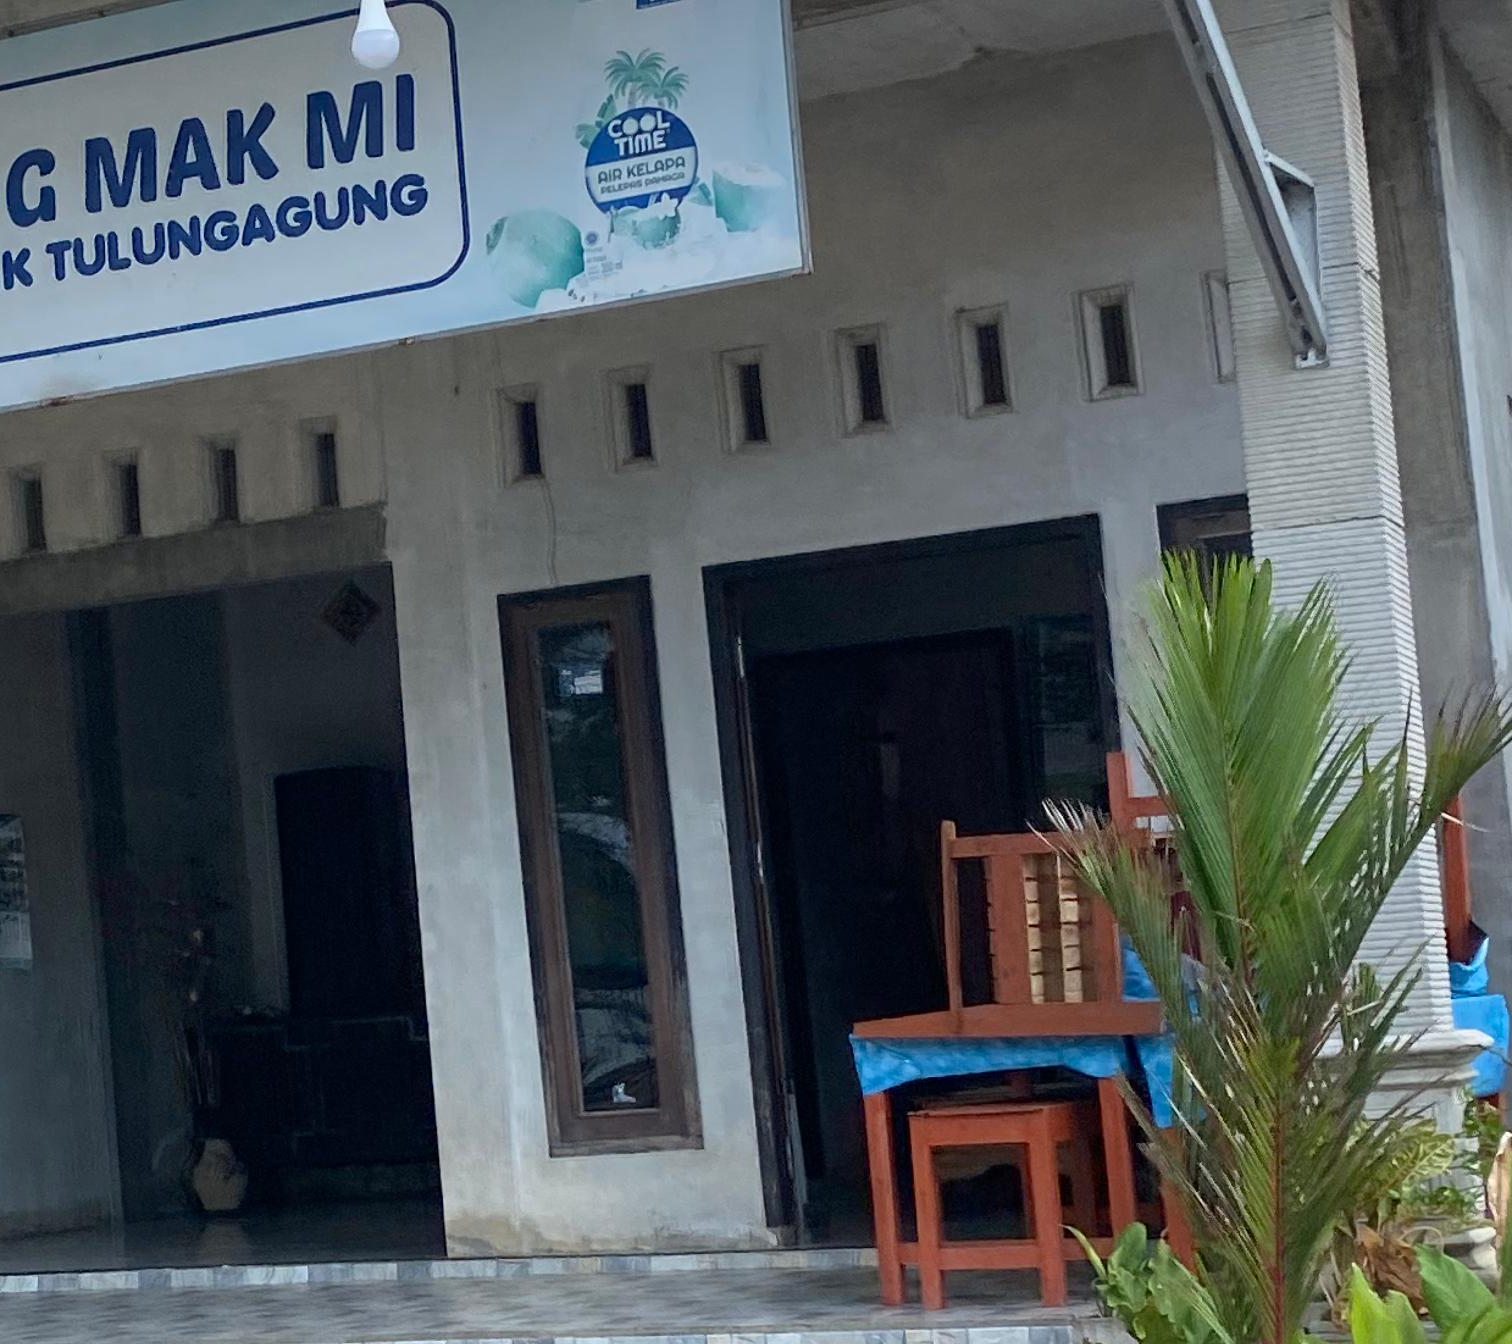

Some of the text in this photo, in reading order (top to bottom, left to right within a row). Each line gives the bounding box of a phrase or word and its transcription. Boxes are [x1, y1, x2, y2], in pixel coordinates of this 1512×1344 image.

[608, 111, 670, 138] COOL
[85, 102, 278, 213] MAK
[307, 73, 414, 170] MI
[614, 130, 666, 156] TIME
[598, 156, 685, 184] AIR KELAPA
[46, 174, 428, 281] TULUNGAGUNG
